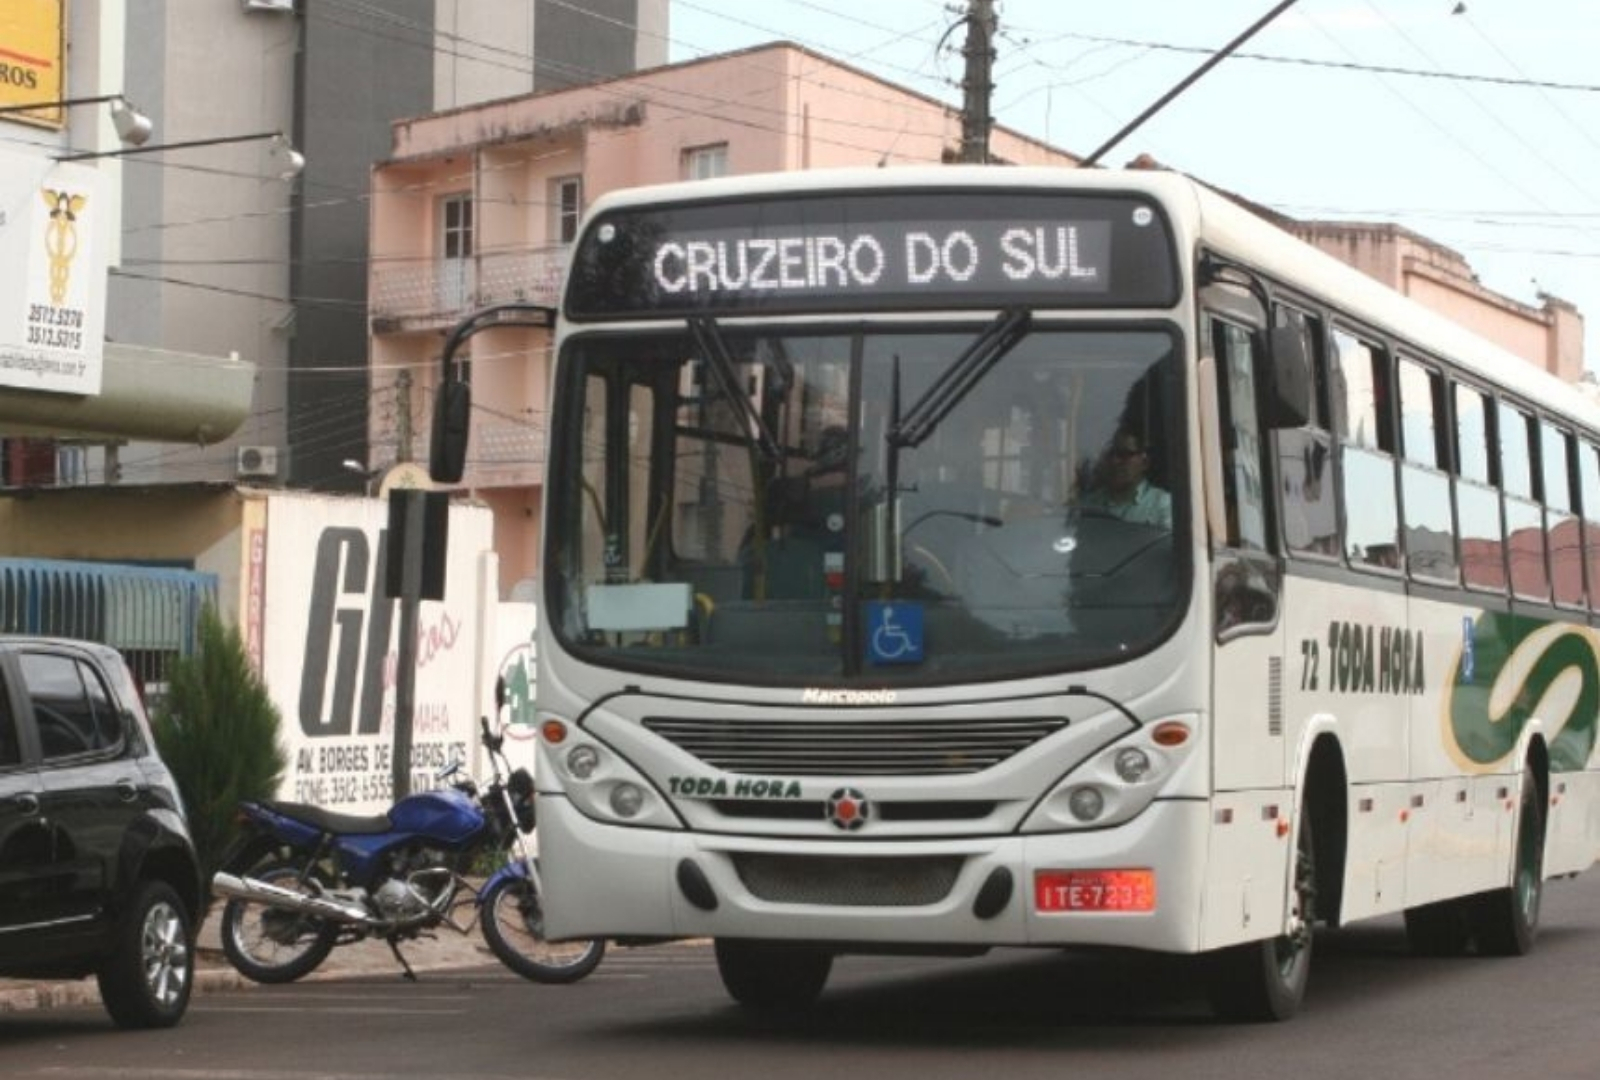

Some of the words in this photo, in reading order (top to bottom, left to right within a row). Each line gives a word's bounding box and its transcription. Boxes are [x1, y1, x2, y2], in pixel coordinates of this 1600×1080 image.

[654, 234, 885, 293] CRUZEIRO
[906, 230, 980, 283] DO
[1001, 226, 1098, 281] SUL
[1301, 638, 1320, 691] 72
[1328, 620, 1375, 694] TODA
[1379, 625, 1425, 695] HORA
[803, 687, 897, 705] Marcopolo
[319, 745, 369, 773] BORGES
[374, 743, 390, 770] DE
[668, 776, 728, 795] TODA
[734, 778, 802, 798] HORA
